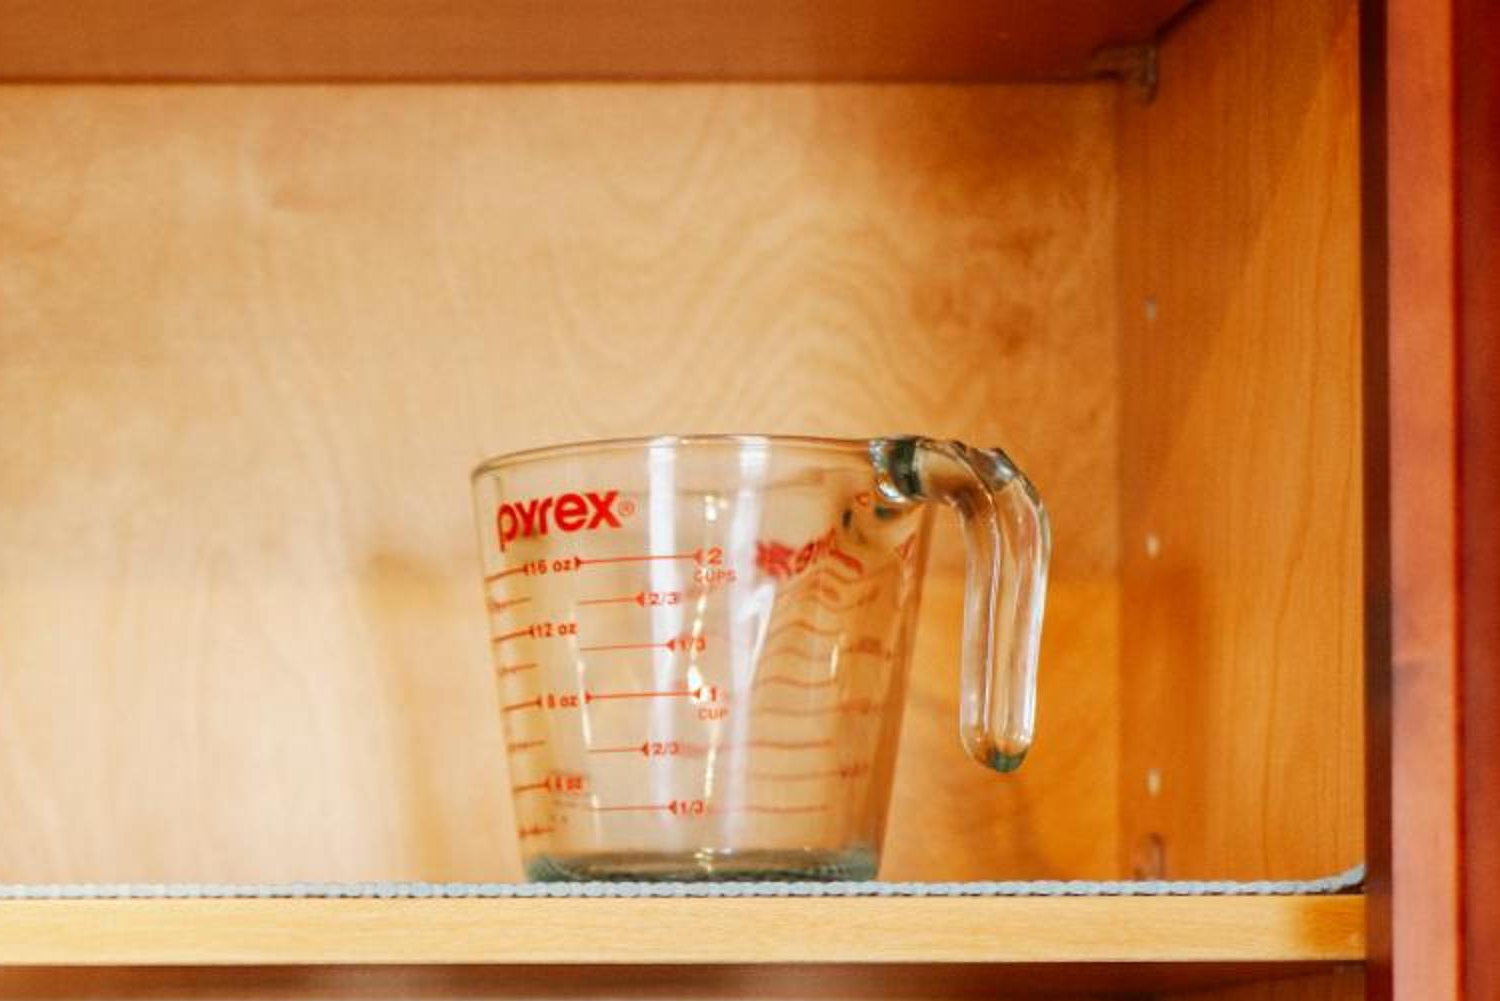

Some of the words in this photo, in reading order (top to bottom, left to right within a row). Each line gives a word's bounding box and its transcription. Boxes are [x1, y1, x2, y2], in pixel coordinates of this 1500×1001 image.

[498, 490, 621, 552] pyrex
[707, 545, 723, 566] 2
[552, 559, 572, 574] oz
[557, 622, 578, 637] oz
